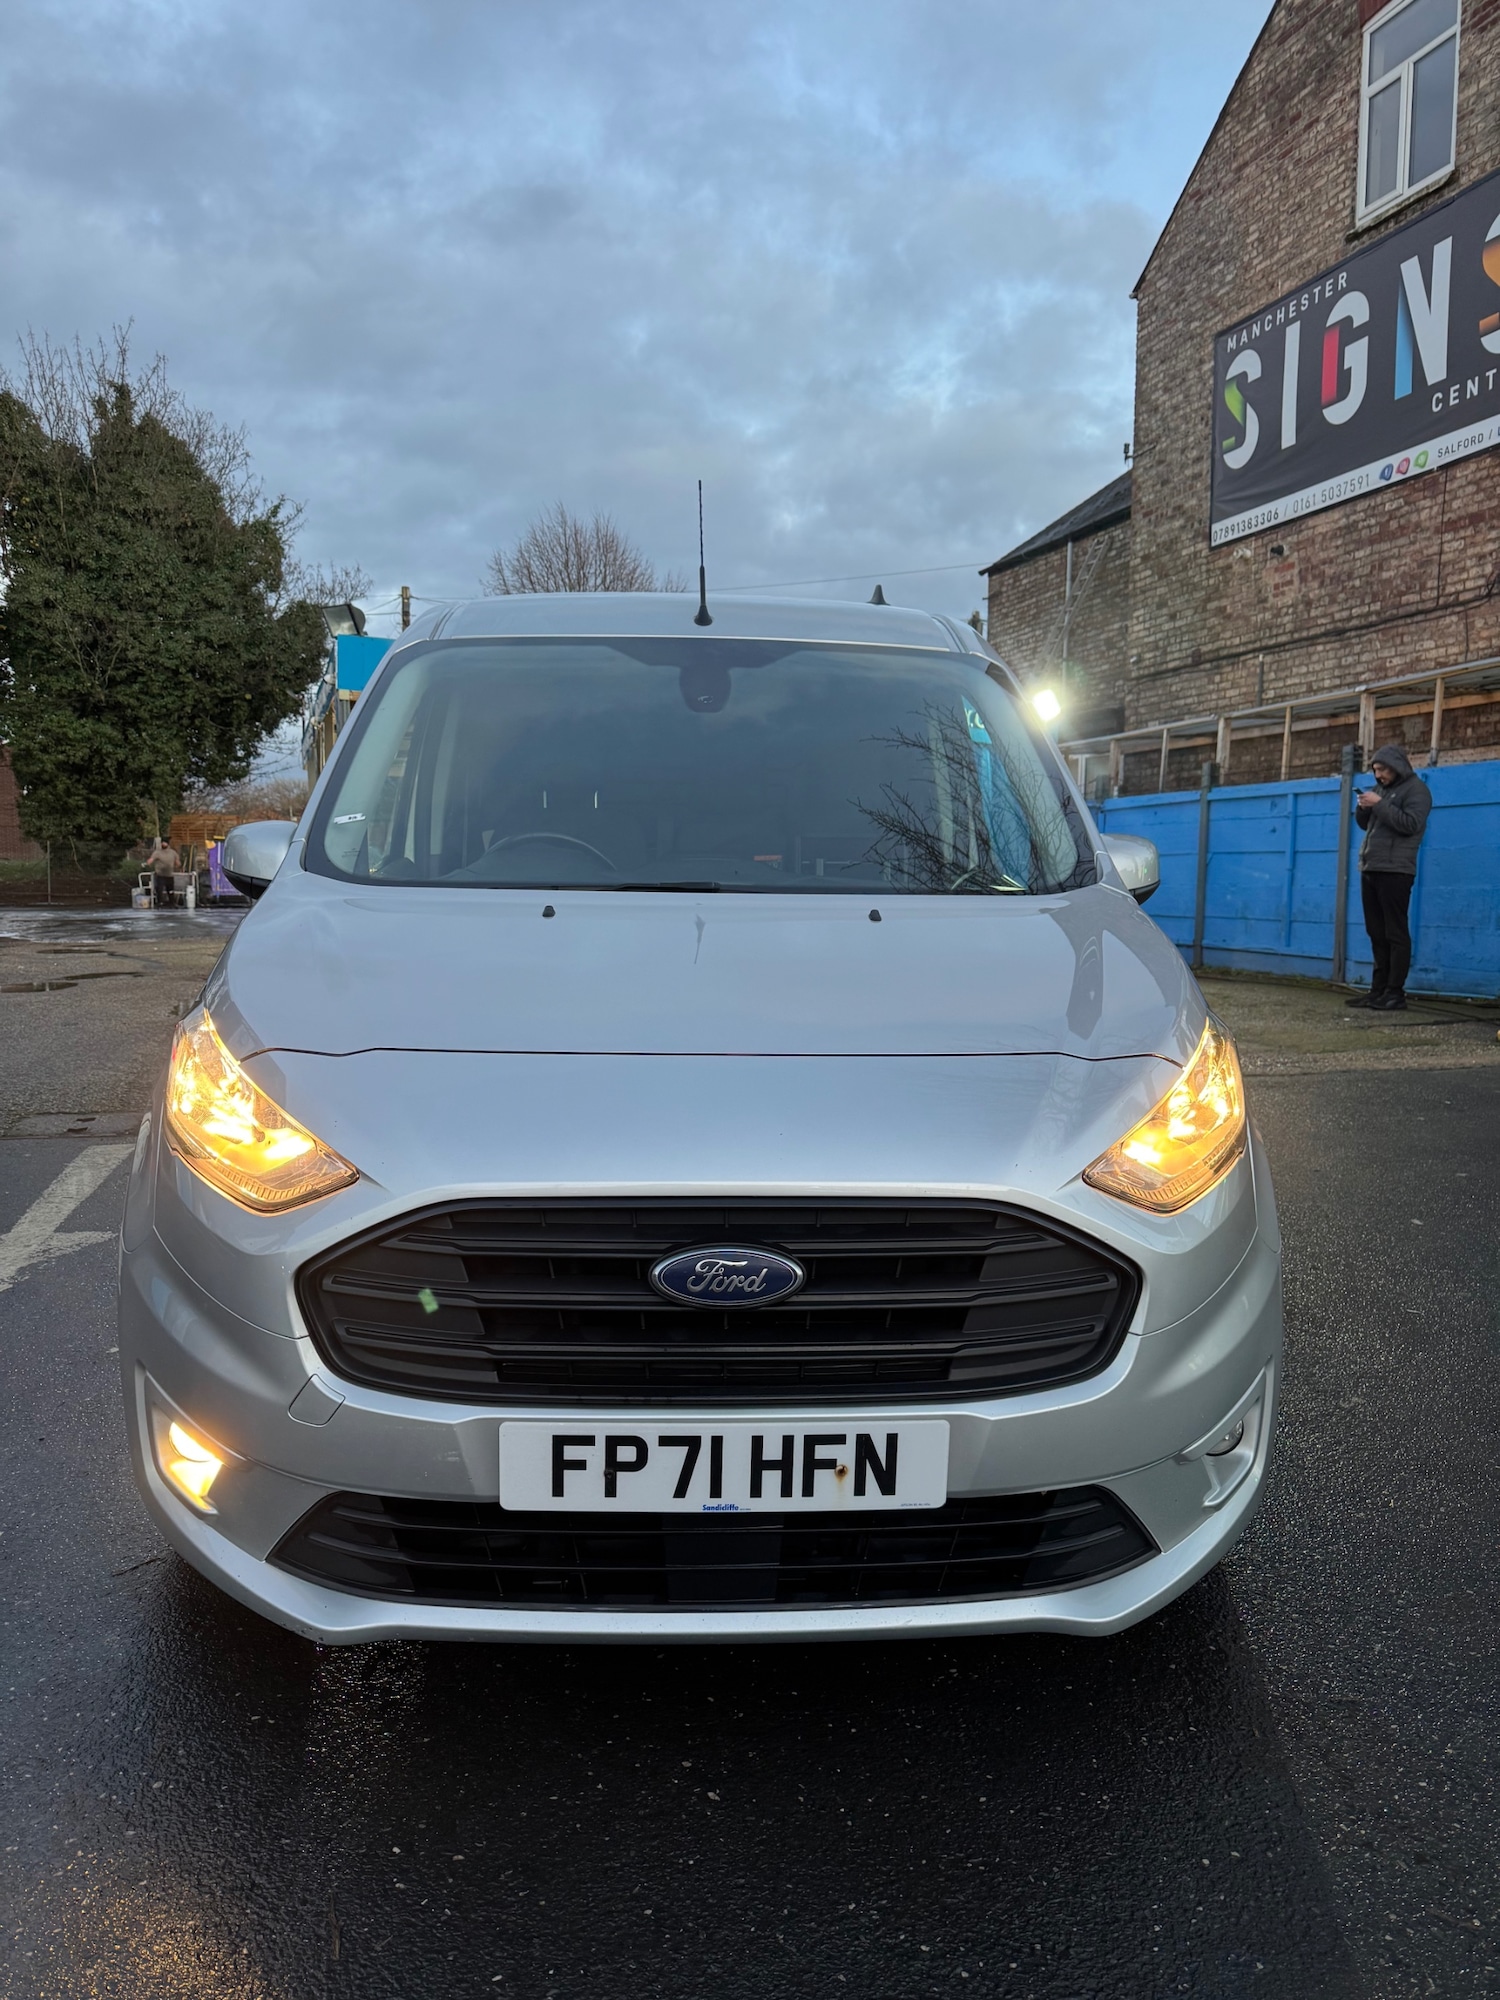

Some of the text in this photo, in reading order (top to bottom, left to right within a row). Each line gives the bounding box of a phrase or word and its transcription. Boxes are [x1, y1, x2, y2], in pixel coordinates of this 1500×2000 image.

[1227, 271, 1348, 353] MANCHESTER
[1431, 368, 1498, 413] CENT
[1212, 507, 1279, 543] 07891383306
[1293, 493, 1317, 514] 0161
[1321, 473, 1370, 504] 5037591
[1437, 433, 1484, 458] SALFORD
[686, 1258, 769, 1293] Ford
[551, 1432, 899, 1499] FP71 HFN
